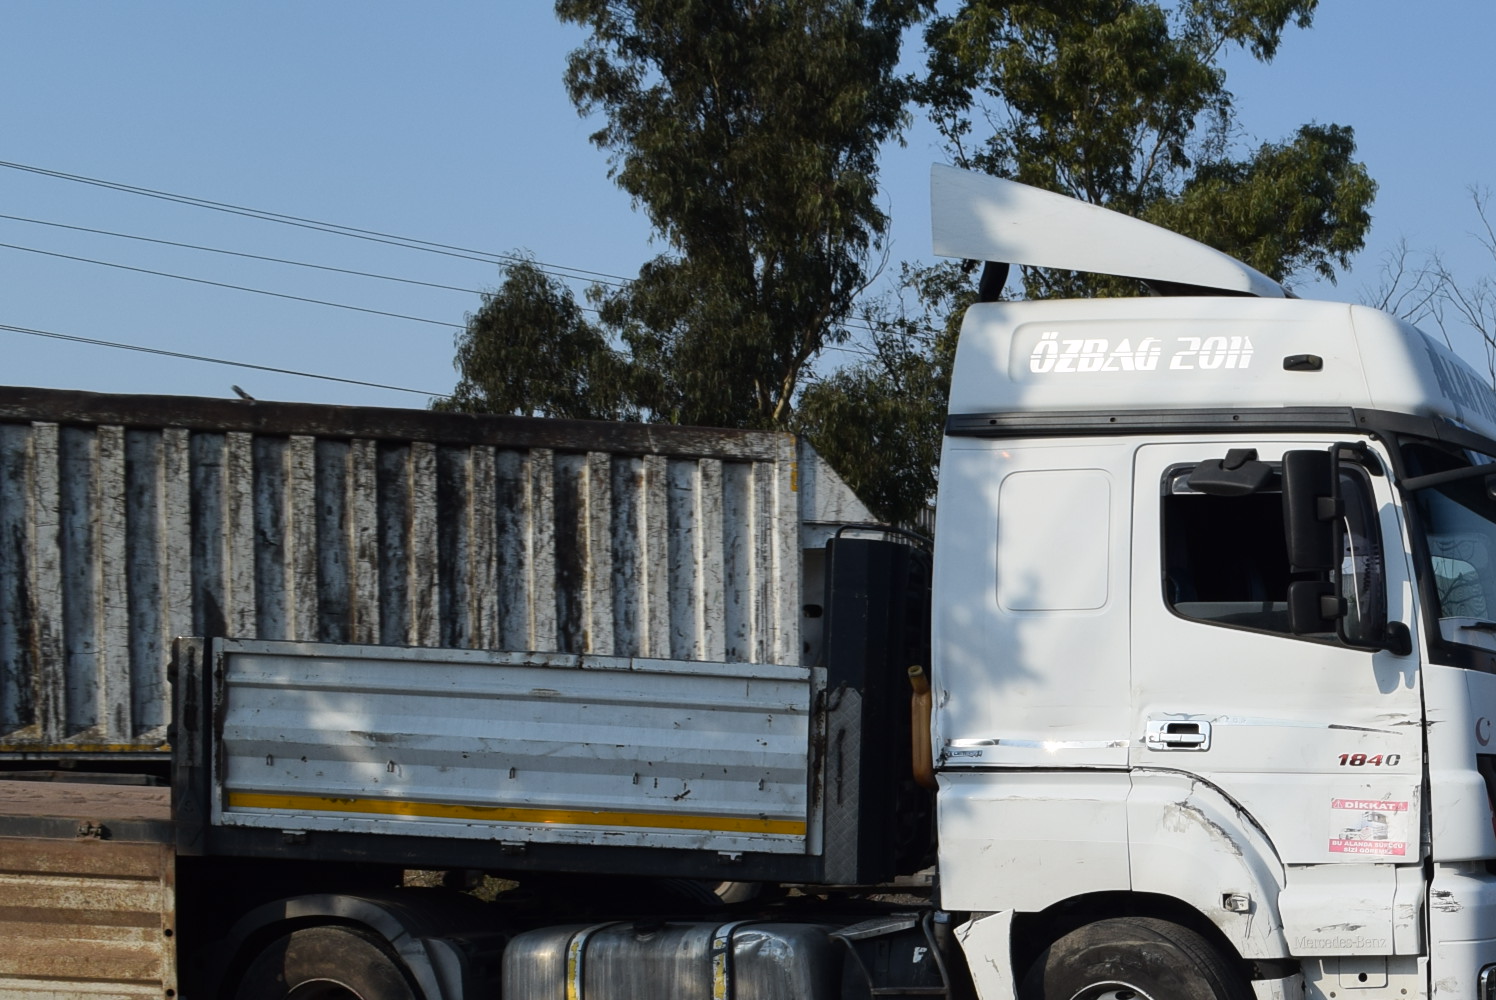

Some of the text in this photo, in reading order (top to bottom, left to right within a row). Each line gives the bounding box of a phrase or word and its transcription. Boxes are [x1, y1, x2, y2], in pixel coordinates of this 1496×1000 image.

[1169, 336, 1254, 370] 2011
[1338, 753, 1401, 767] 1840
[1344, 800, 1396, 810] DİKKAT
[1294, 936, 1387, 949] Mercedes-Benz
